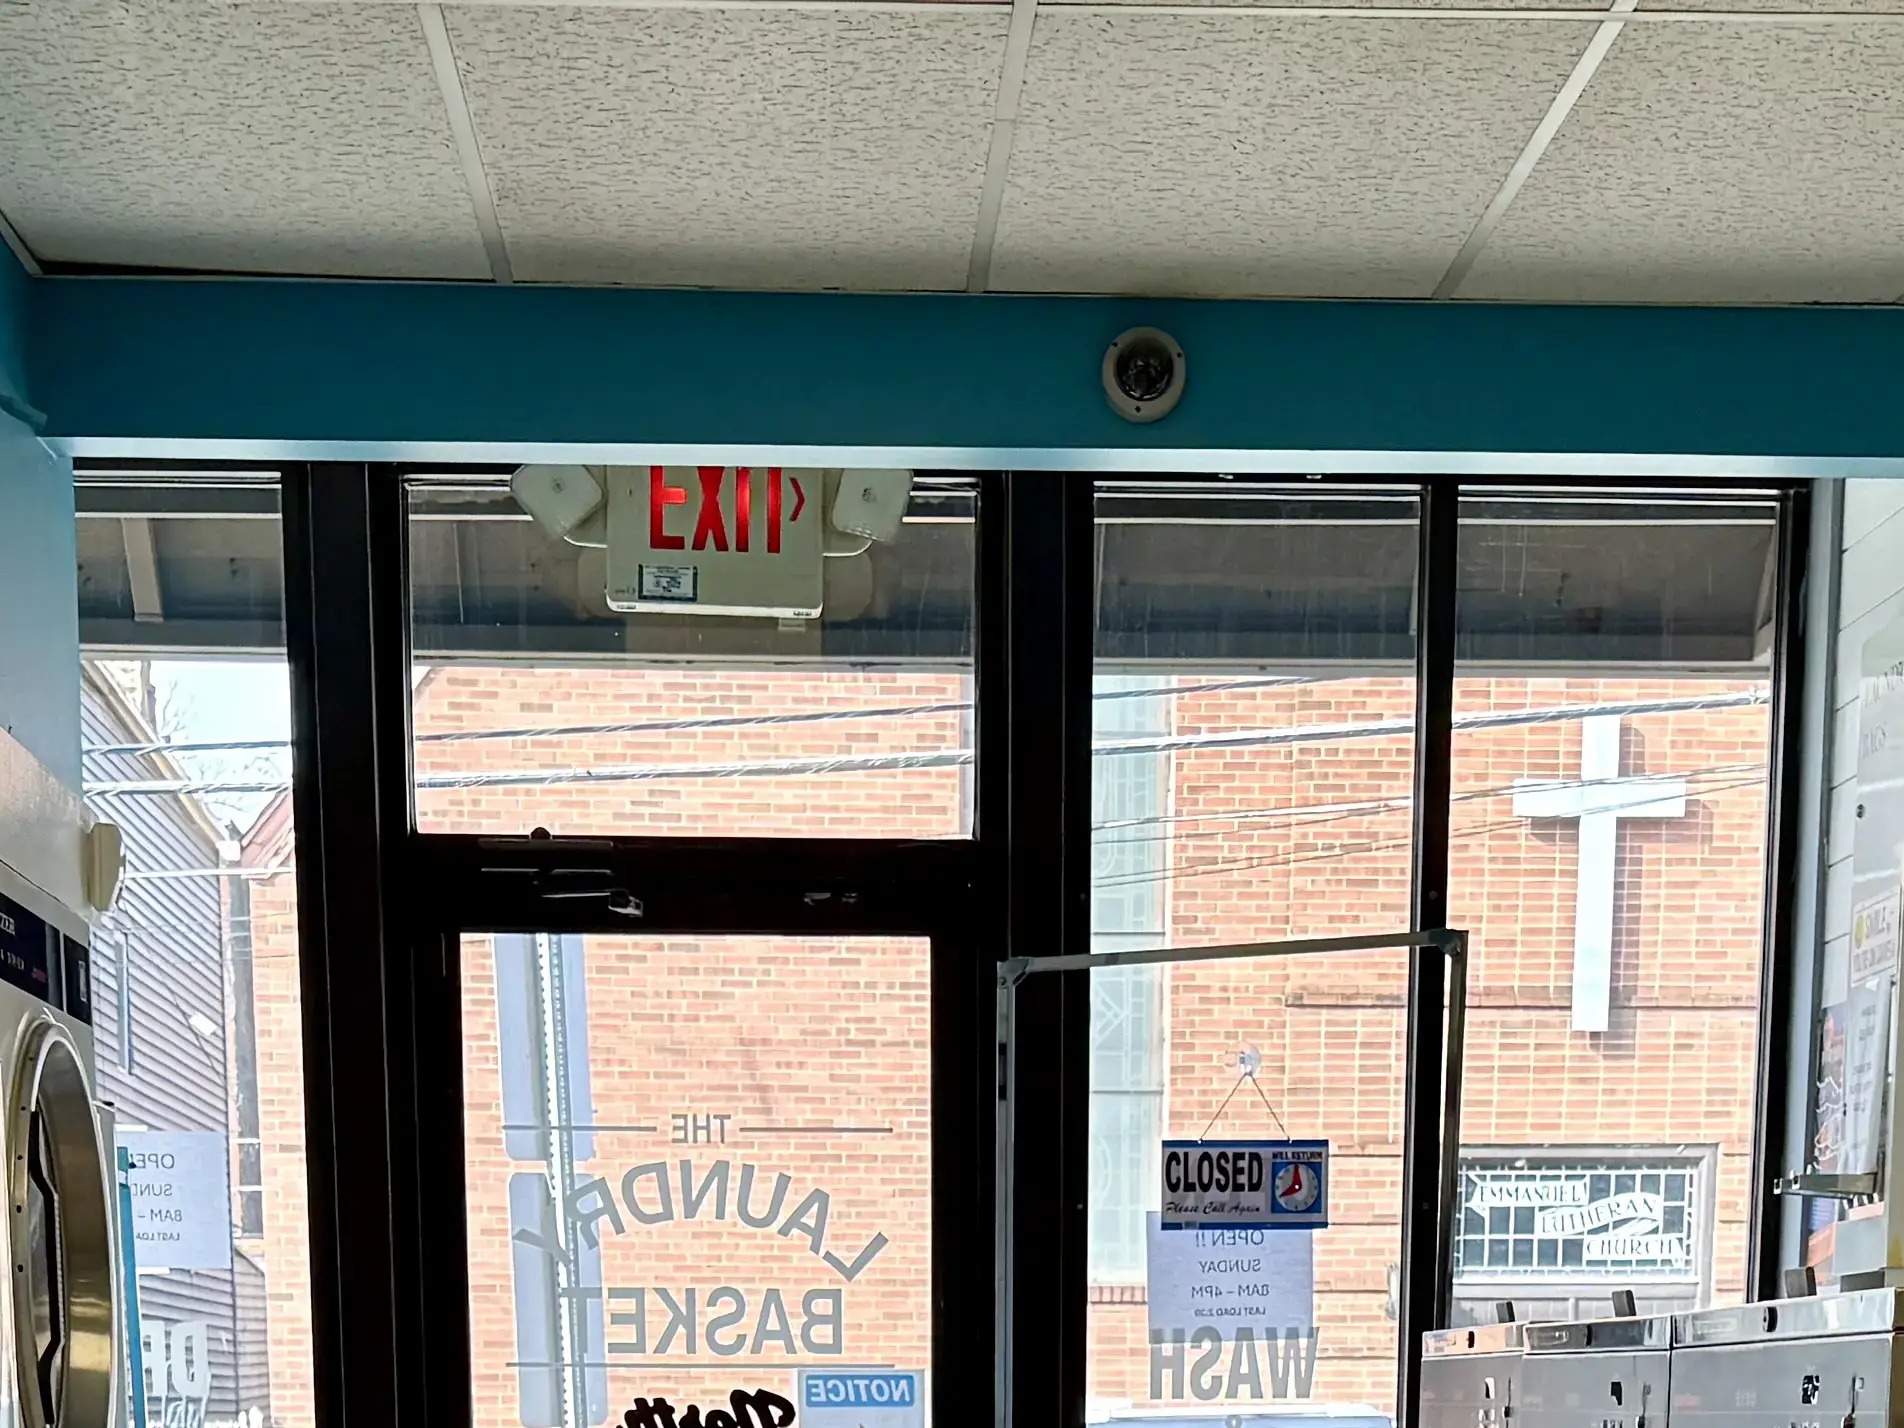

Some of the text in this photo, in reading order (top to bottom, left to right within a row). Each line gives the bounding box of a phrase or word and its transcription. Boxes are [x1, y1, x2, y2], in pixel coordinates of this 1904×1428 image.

[649, 466, 782, 553] EXIT
[1272, 1151, 1323, 1160] WILL RETURN
[1165, 1151, 1264, 1193] CLOSED
[1480, 1184, 1582, 1203] EMMANUEL
[1166, 1201, 1260, 1215] Please Call Again
[1541, 1199, 1657, 1234] LUTHERAN
[1586, 1238, 1672, 1256] CHURCH
